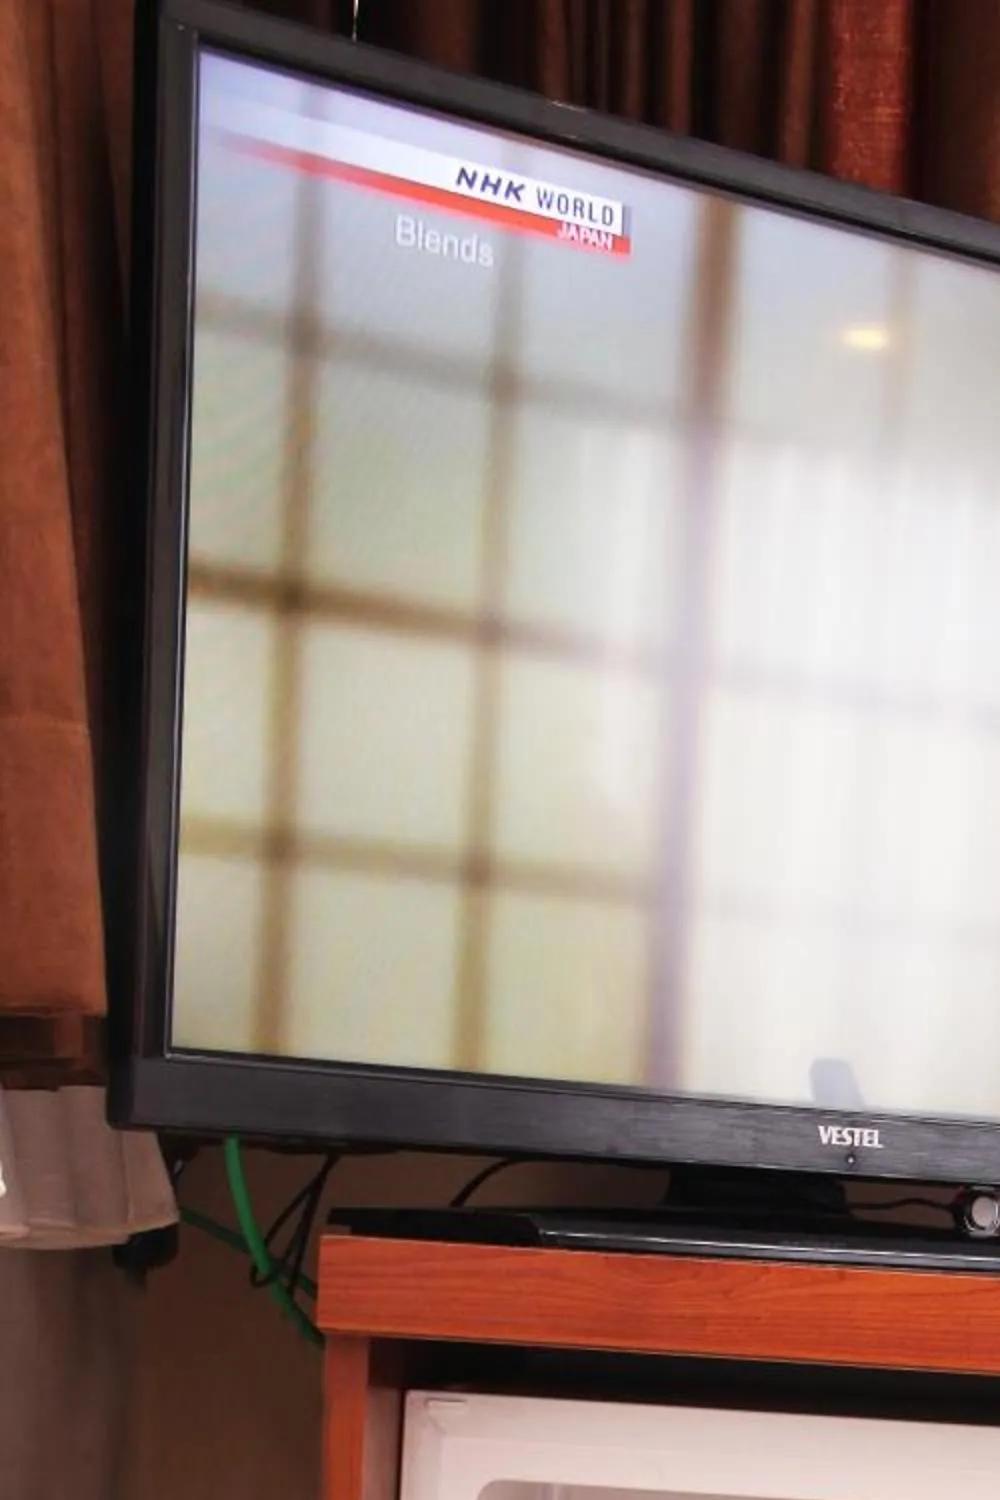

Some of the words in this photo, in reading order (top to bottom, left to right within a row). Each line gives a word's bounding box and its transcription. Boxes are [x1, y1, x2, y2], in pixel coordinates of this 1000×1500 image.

[456, 167, 526, 202] NHK
[536, 187, 616, 227] WORLD
[394, 214, 495, 267] Blends
[556, 220, 614, 251] JAPAN
[818, 1125, 884, 1148] VESTEL
